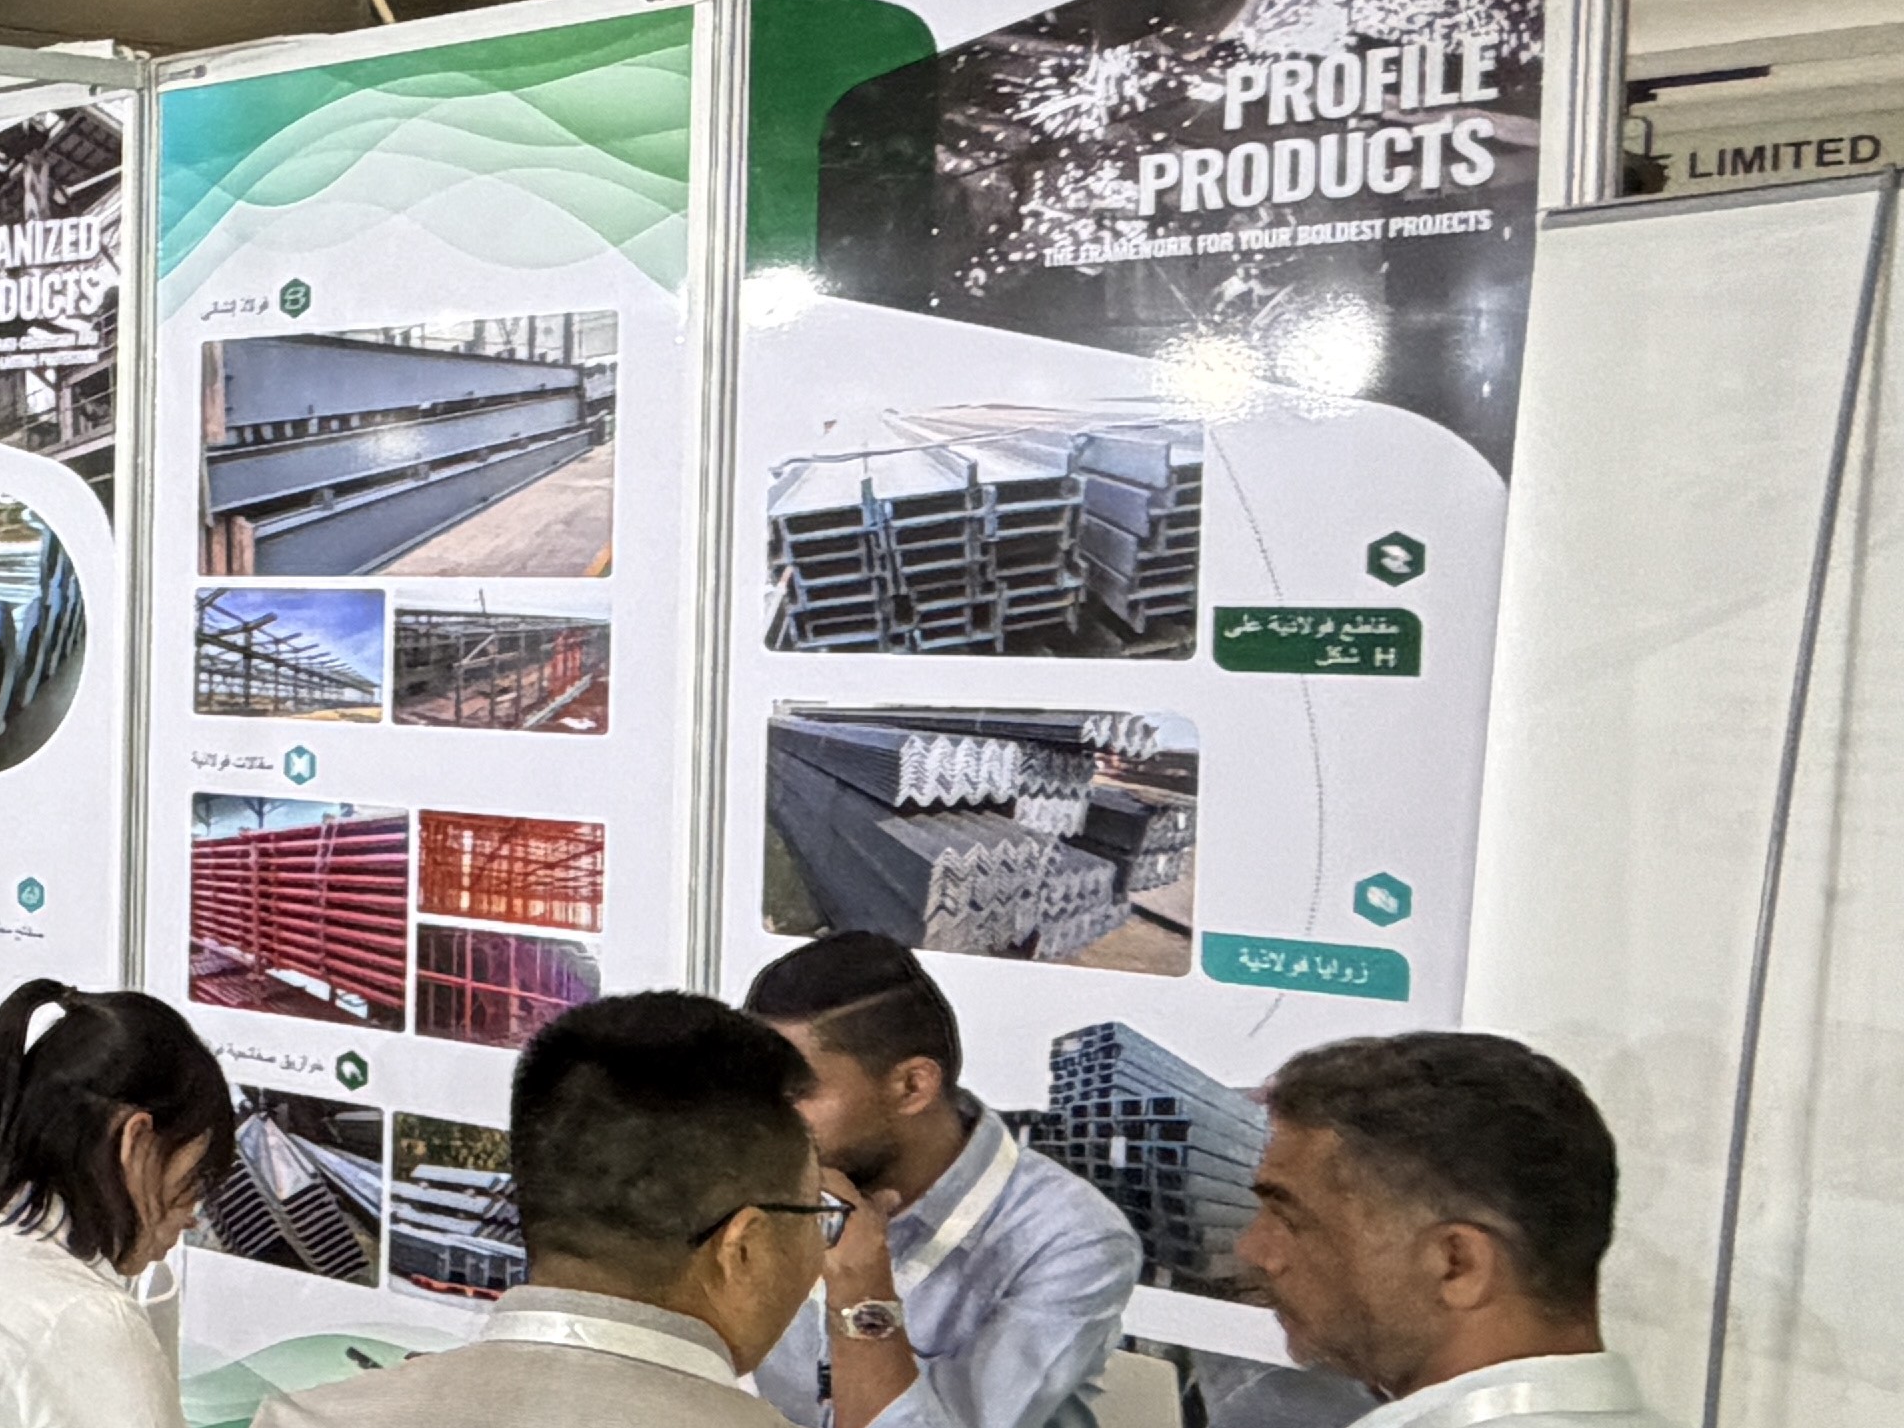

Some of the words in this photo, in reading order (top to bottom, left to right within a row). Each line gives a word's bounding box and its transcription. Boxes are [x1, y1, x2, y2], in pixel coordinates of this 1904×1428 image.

[1224, 33, 1500, 131] PROFILE
[1138, 118, 1495, 217] PRODUCTS
[1688, 134, 1882, 179] LIMITED
[1042, 245, 1078, 268] THE
[1197, 232, 1234, 255] FOR
[1240, 227, 1292, 253] YOUR
[1297, 219, 1384, 247] BOLDEST
[1388, 209, 1492, 238] PROJECTS
[1374, 646, 1397, 668] H
